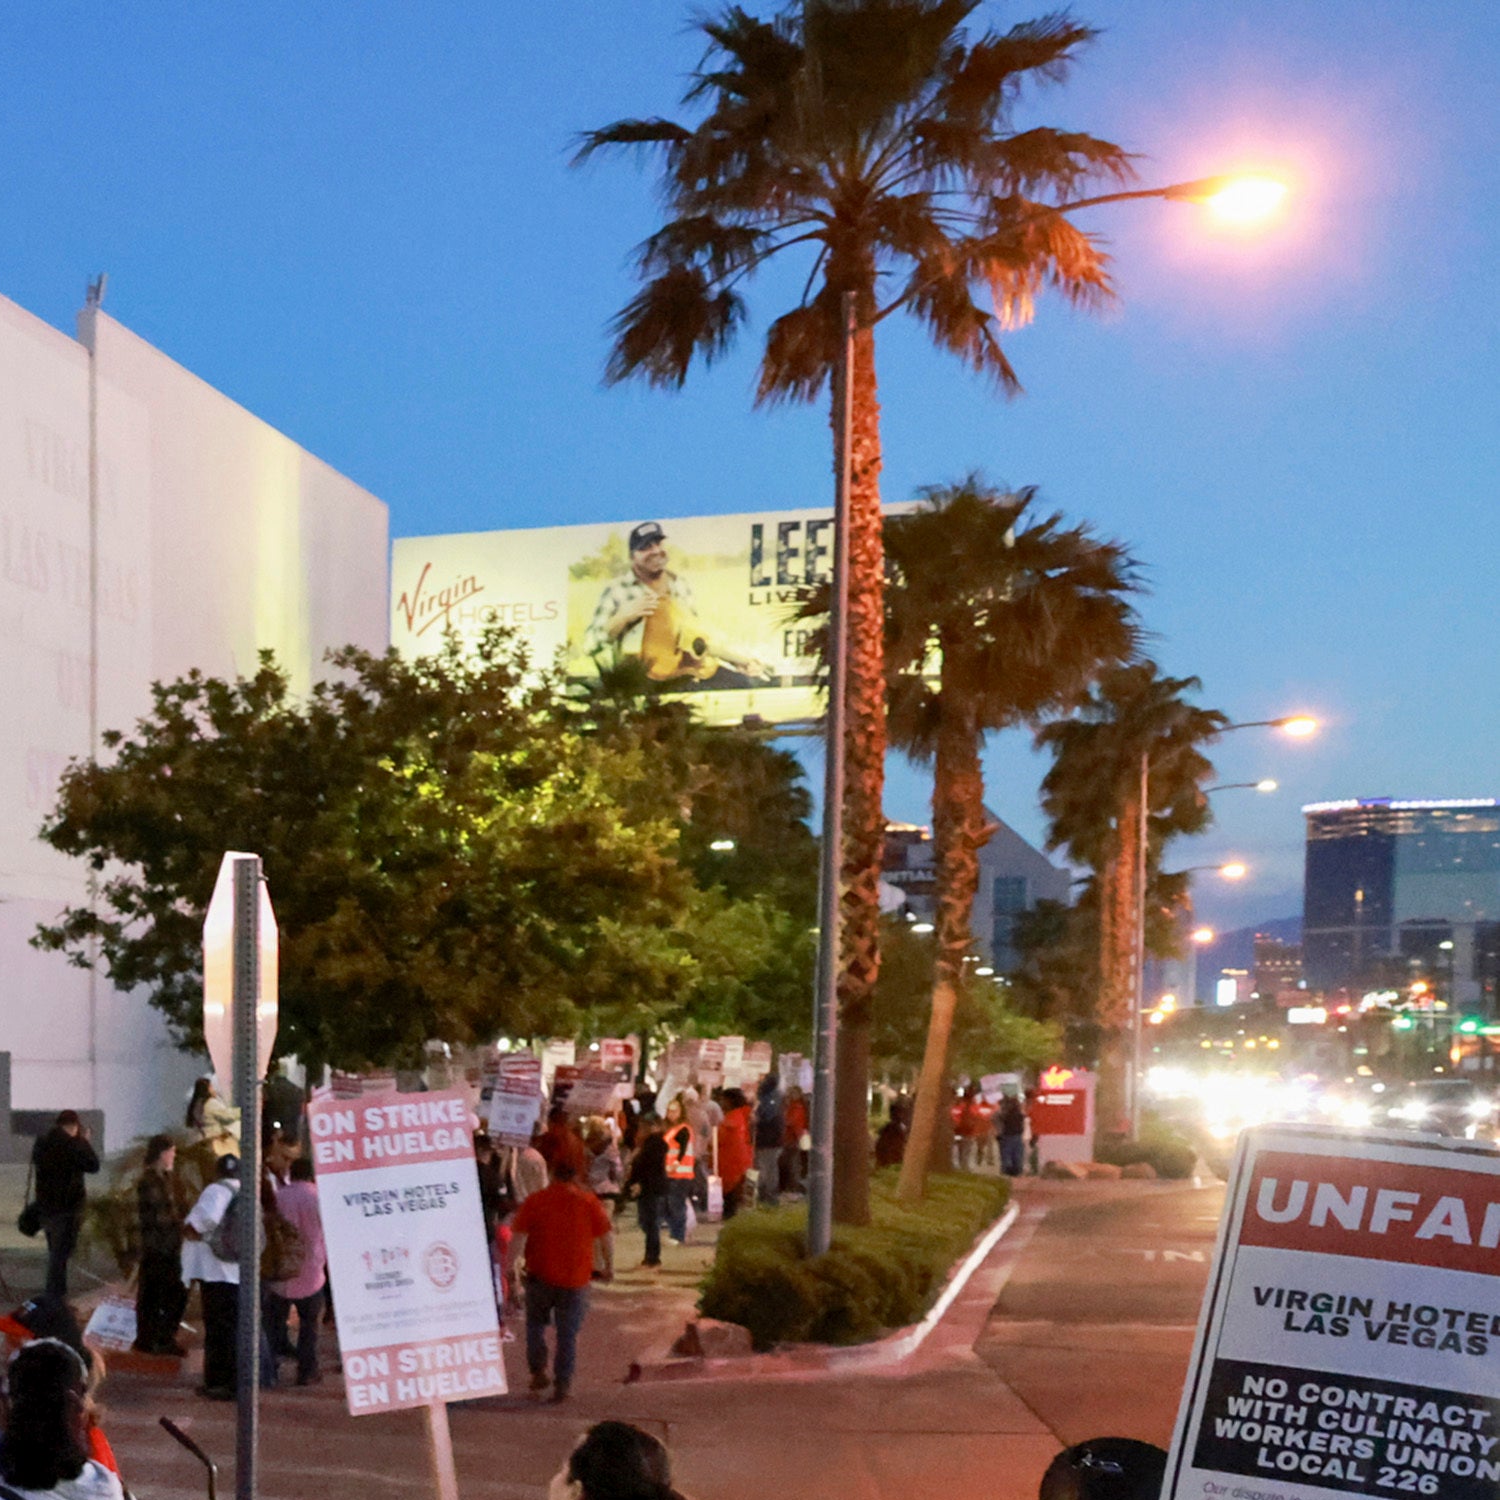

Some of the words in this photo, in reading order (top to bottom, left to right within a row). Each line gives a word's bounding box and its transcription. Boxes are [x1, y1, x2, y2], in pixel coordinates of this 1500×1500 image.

[397, 562, 484, 636] Virgin
[458, 601, 558, 624] HOTELS
[312, 1110, 356, 1136] ON
[364, 1099, 467, 1132] STRIKE
[316, 1139, 354, 1164] EN
[362, 1127, 470, 1159] HUELGA
[343, 1189, 399, 1206] VIRGIN
[404, 1181, 460, 1200] HOTELS
[363, 1202, 394, 1218] LAS
[399, 1197, 446, 1212] VEGAS
[1256, 1177, 1500, 1249] UNFAI
[1253, 1287, 1373, 1317] VIRGIN
[1386, 1302, 1500, 1336] HOTEL
[1284, 1311, 1350, 1338] LAS
[1365, 1320, 1488, 1355] VEGAS
[347, 1352, 390, 1380] ON
[398, 1337, 500, 1373] STRIKE
[351, 1383, 390, 1408] EN
[398, 1367, 503, 1399] HUELGA
[1243, 1375, 1288, 1398] NO
[1299, 1382, 1490, 1430] CONTRACT
[1228, 1396, 1307, 1425] WITH
[1318, 1411, 1498, 1456] CULINARY
[1215, 1417, 1375, 1459] WORKERS
[1387, 1444, 1500, 1482] UNION
[1258, 1449, 1365, 1482] LOCAL
[1377, 1467, 1439, 1495] 226
